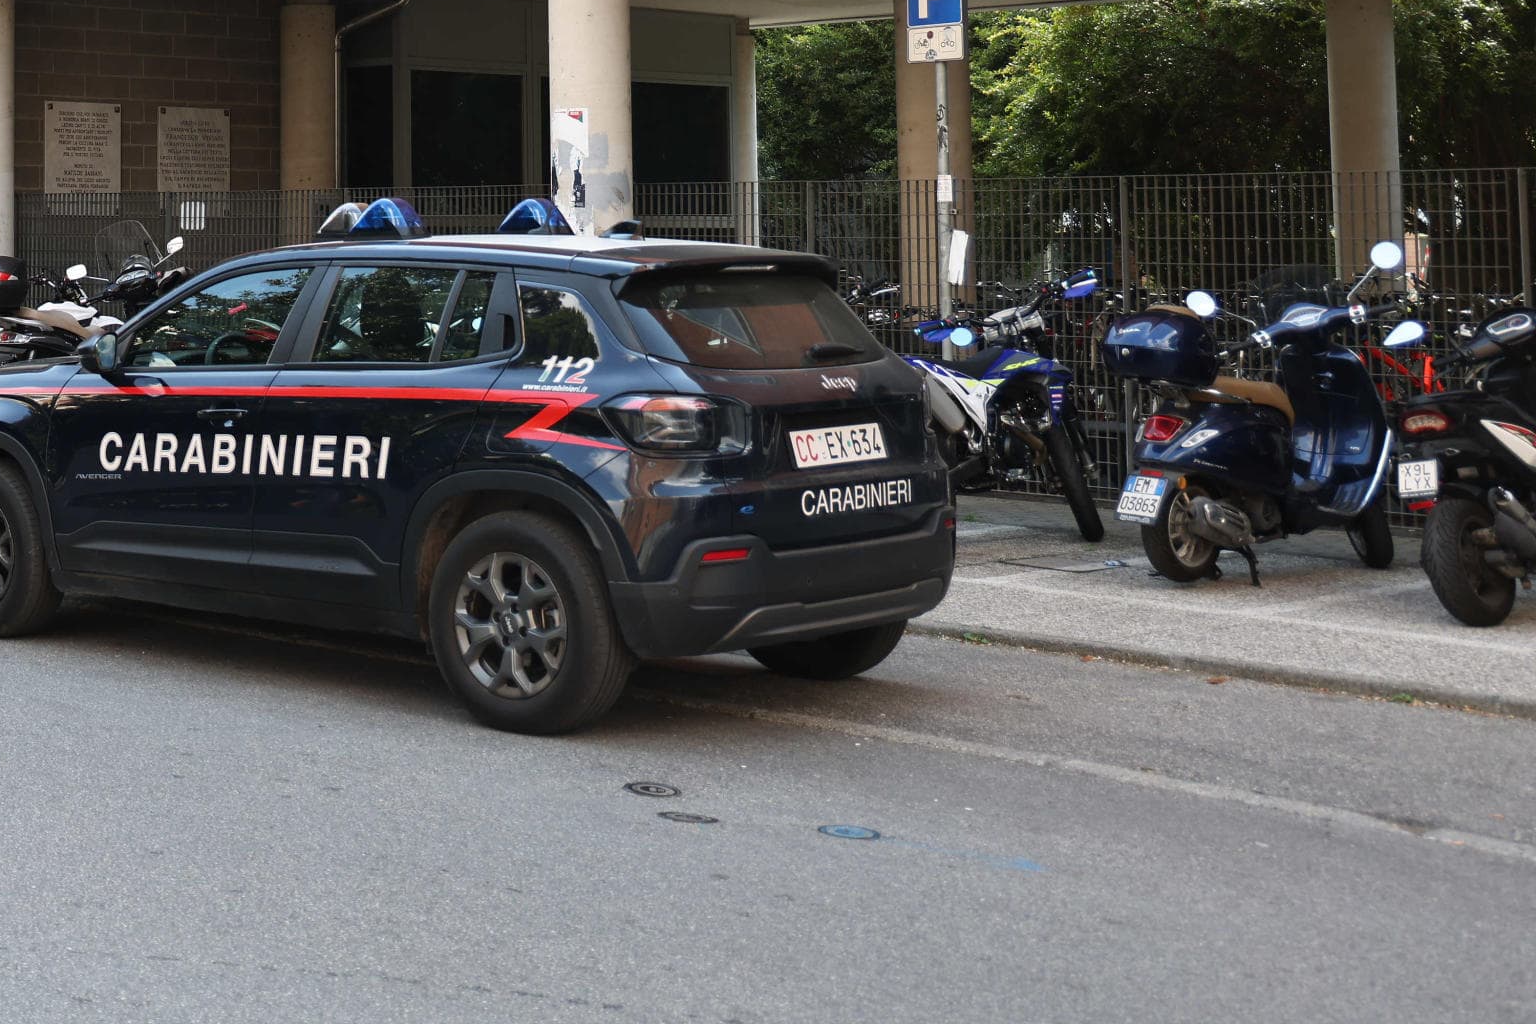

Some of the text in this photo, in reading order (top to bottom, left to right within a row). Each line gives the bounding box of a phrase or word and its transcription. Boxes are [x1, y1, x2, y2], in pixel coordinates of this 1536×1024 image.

[538, 355, 595, 384] 112
[522, 383, 588, 393] www.carabinieri.it
[820, 374, 857, 393] Jeep
[795, 427, 882, 462] CC EX 634
[99, 431, 391, 480] CARABINIERI
[1404, 464, 1431, 477] X9L
[1135, 478, 1151, 492] EM
[1404, 477, 1432, 491] LYX
[801, 478, 912, 516] CARABINIERI
[1119, 495, 1158, 514] 03863
